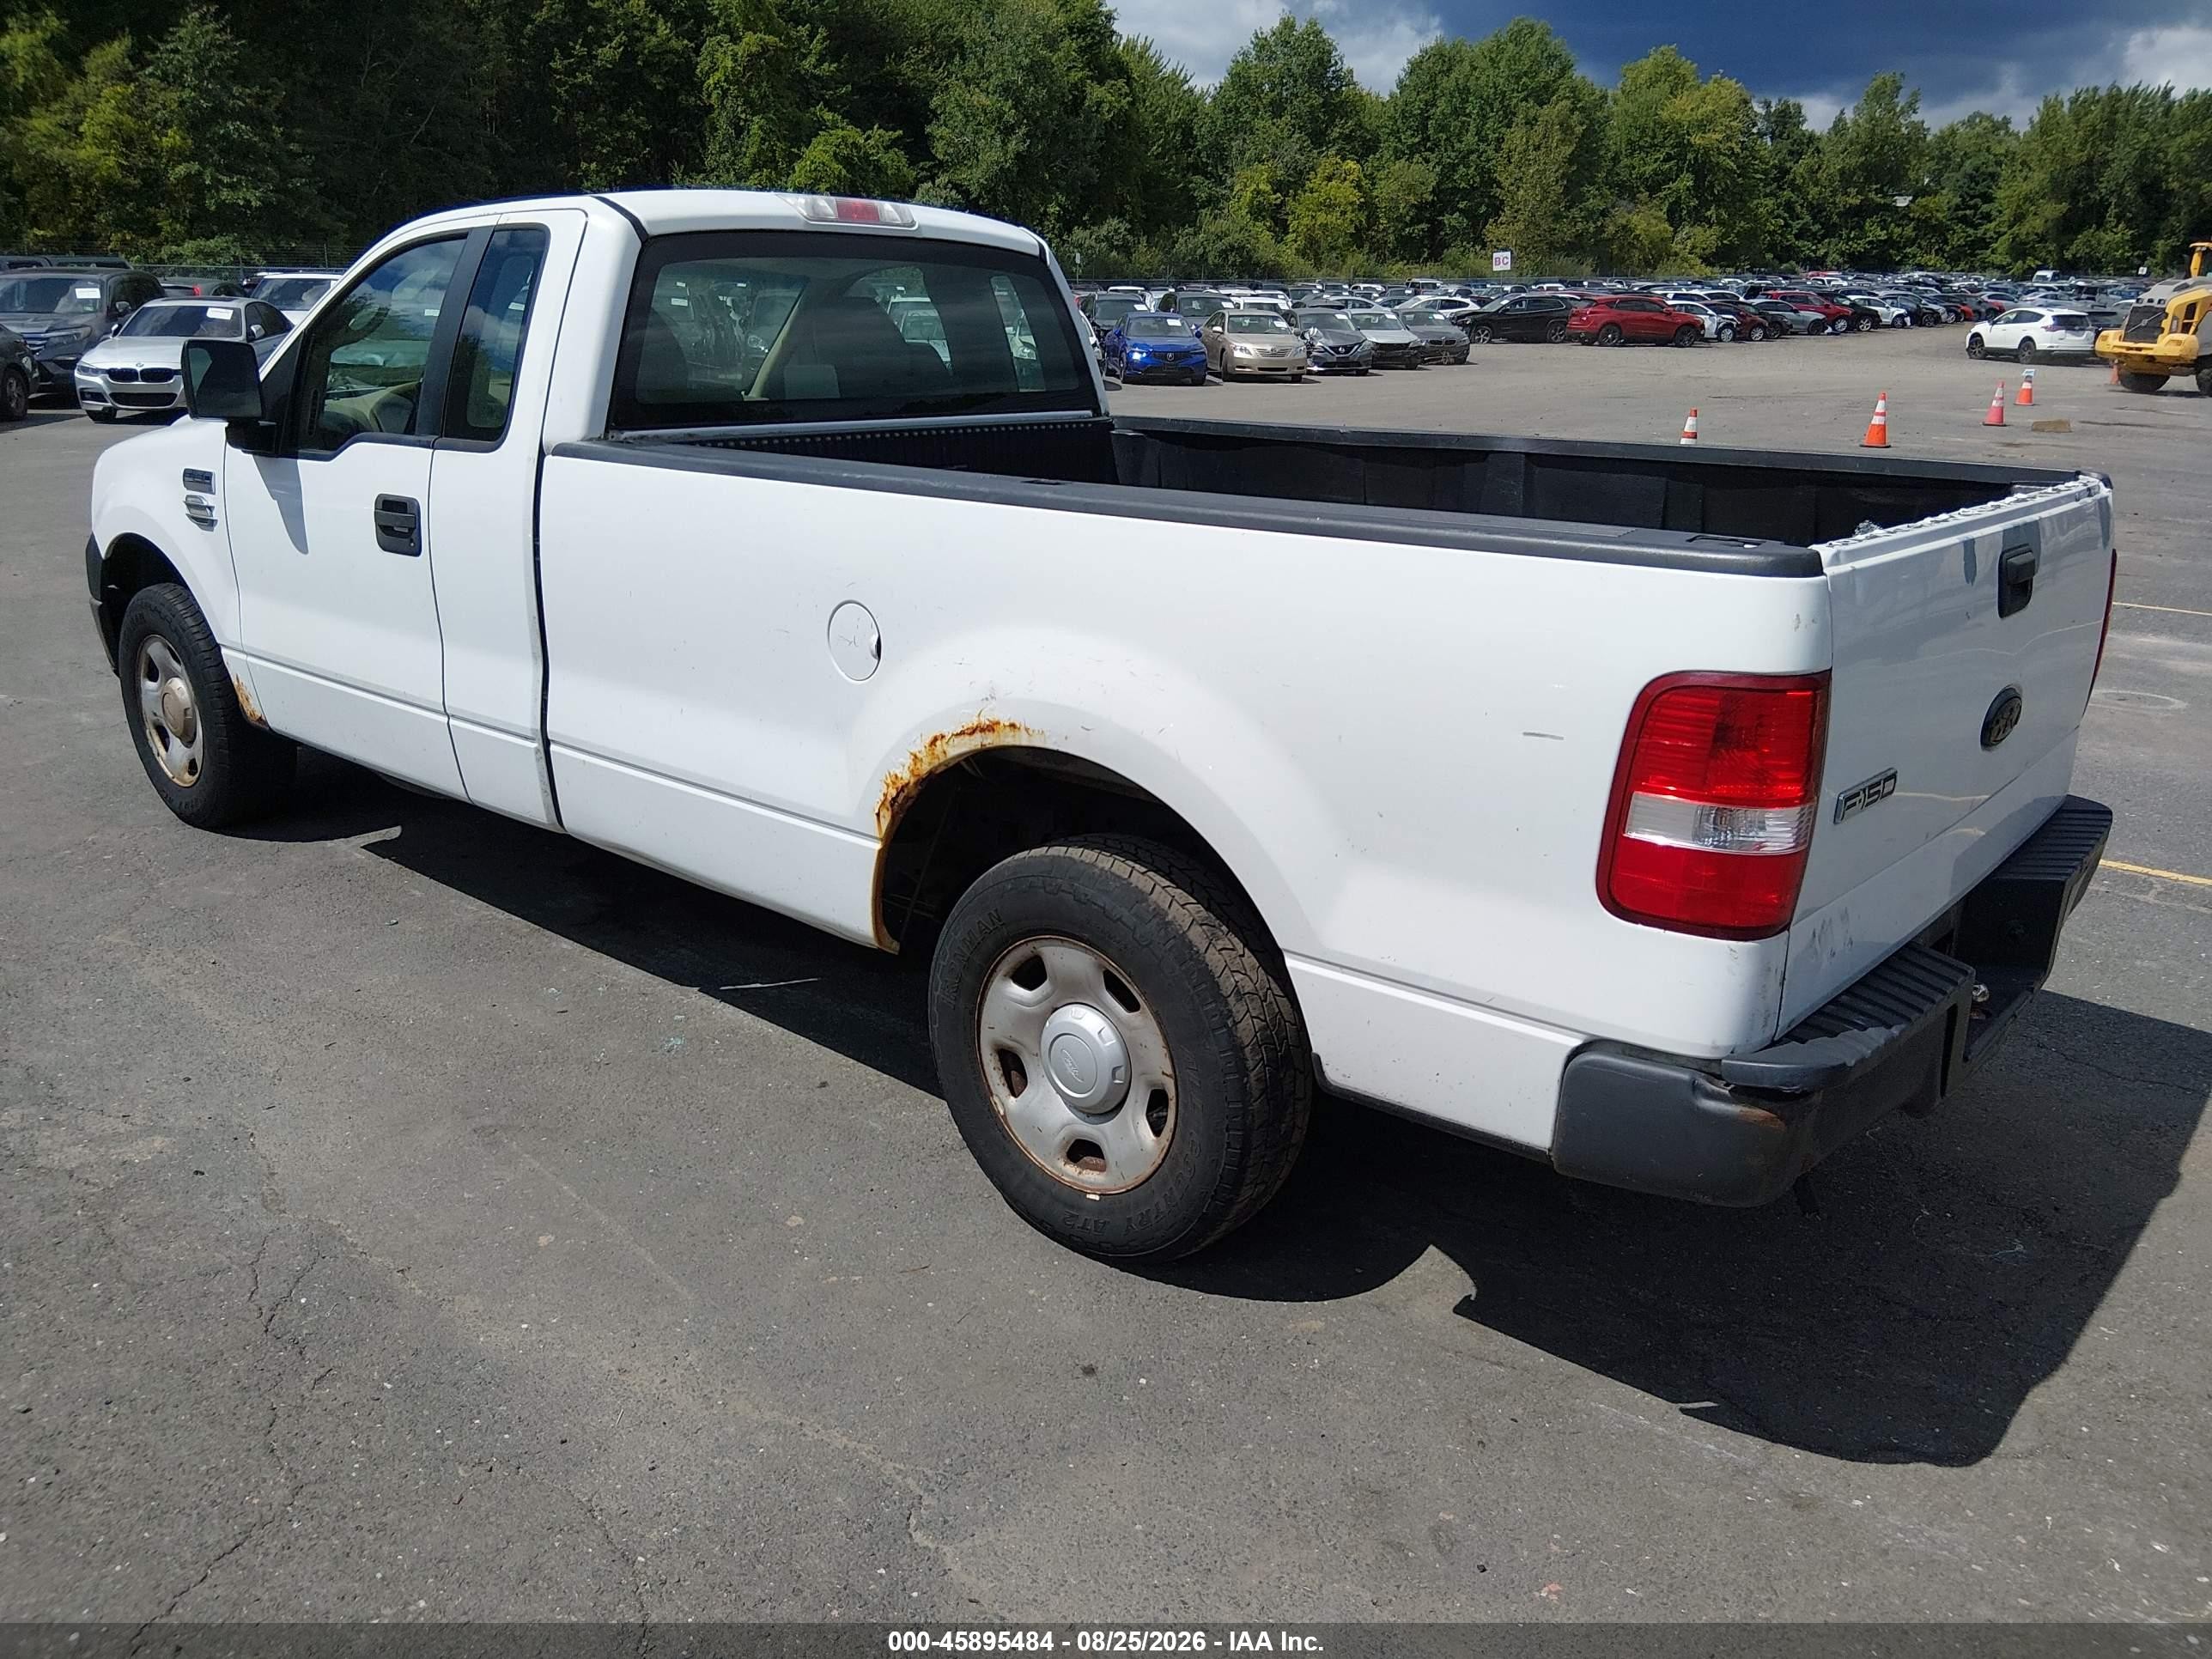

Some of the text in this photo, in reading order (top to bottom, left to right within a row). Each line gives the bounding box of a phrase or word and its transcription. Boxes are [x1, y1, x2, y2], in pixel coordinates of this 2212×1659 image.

[1494, 256, 1510, 266] BC
[939, 907, 1006, 1010] IRONMAN
[1063, 1209, 1111, 1237] AT2
